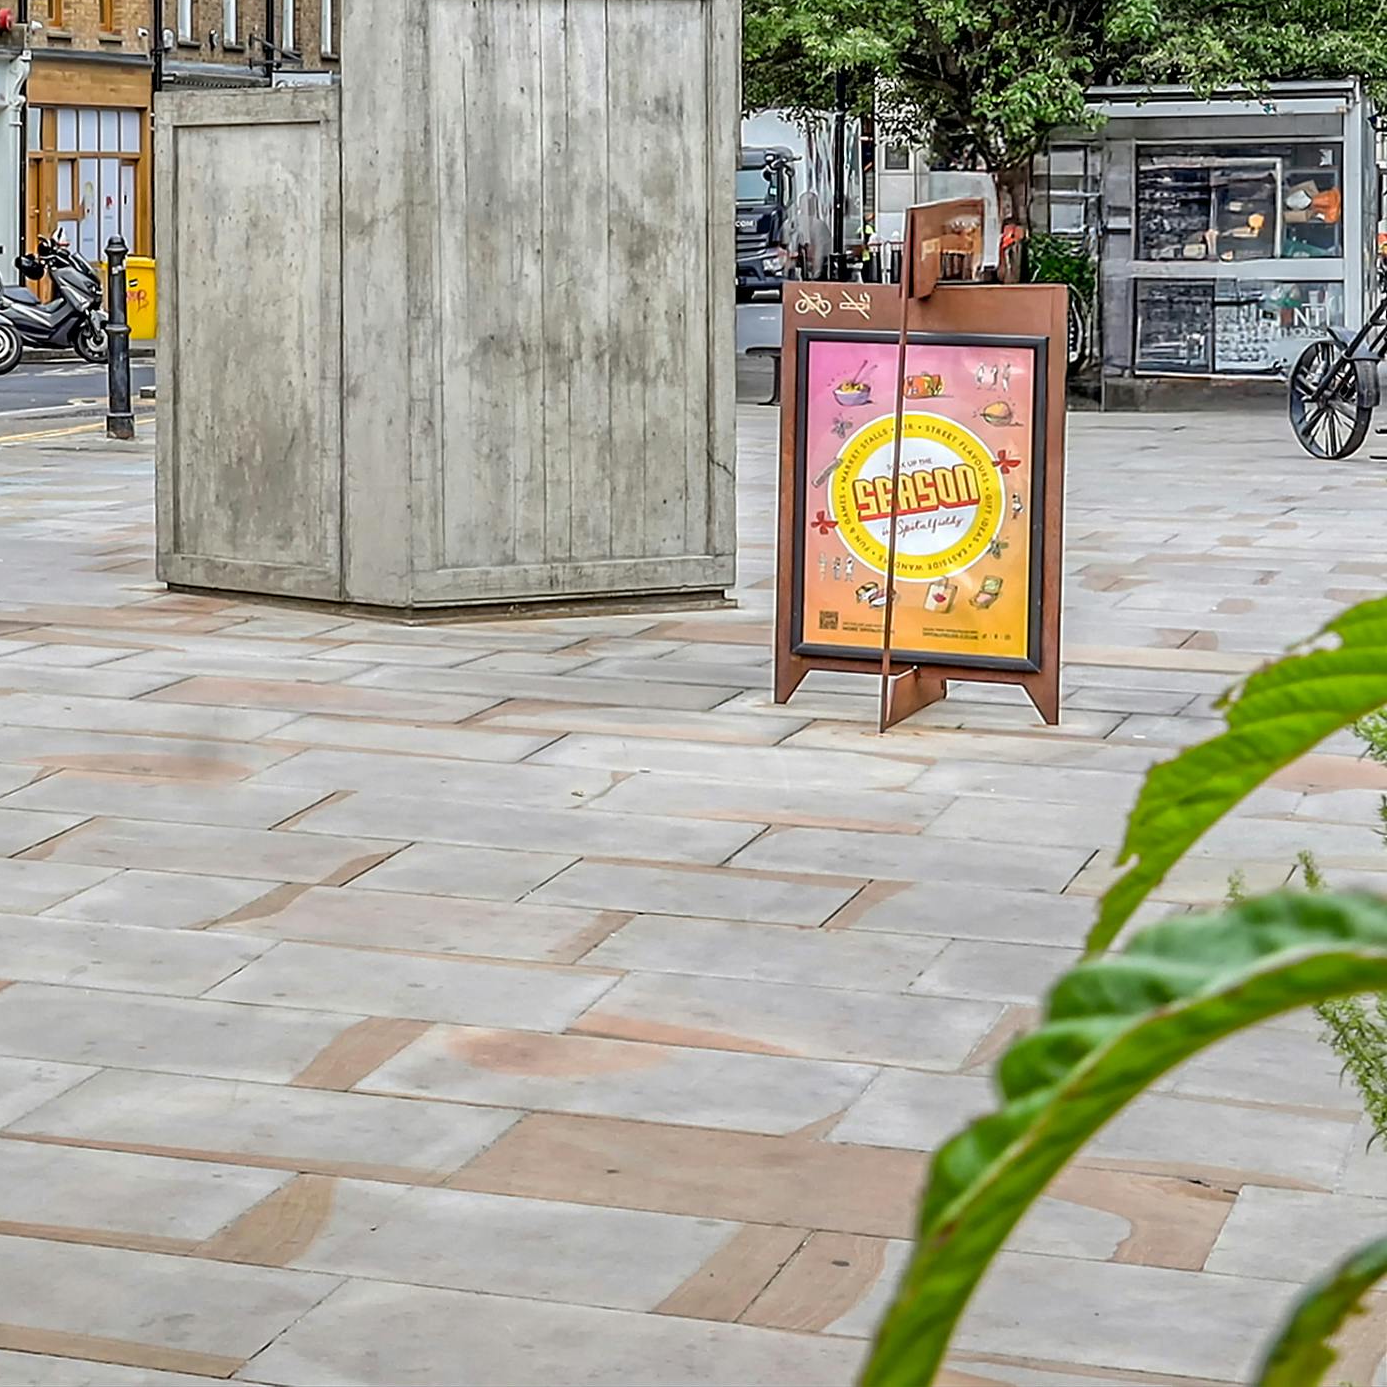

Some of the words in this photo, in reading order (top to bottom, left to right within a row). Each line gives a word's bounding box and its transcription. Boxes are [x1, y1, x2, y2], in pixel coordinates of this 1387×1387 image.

[860, 428, 888, 450] STALLS
[925, 425, 958, 443] STREET
[958, 441, 990, 483] FLAVOURS
[852, 463, 980, 521] SEASON
[839, 494, 852, 525] GAMES
[985, 493, 993, 515] GIFT
[972, 517, 989, 542] IDEAS
[854, 535, 871, 552] FUN
[928, 547, 968, 570] EASTSIDE
